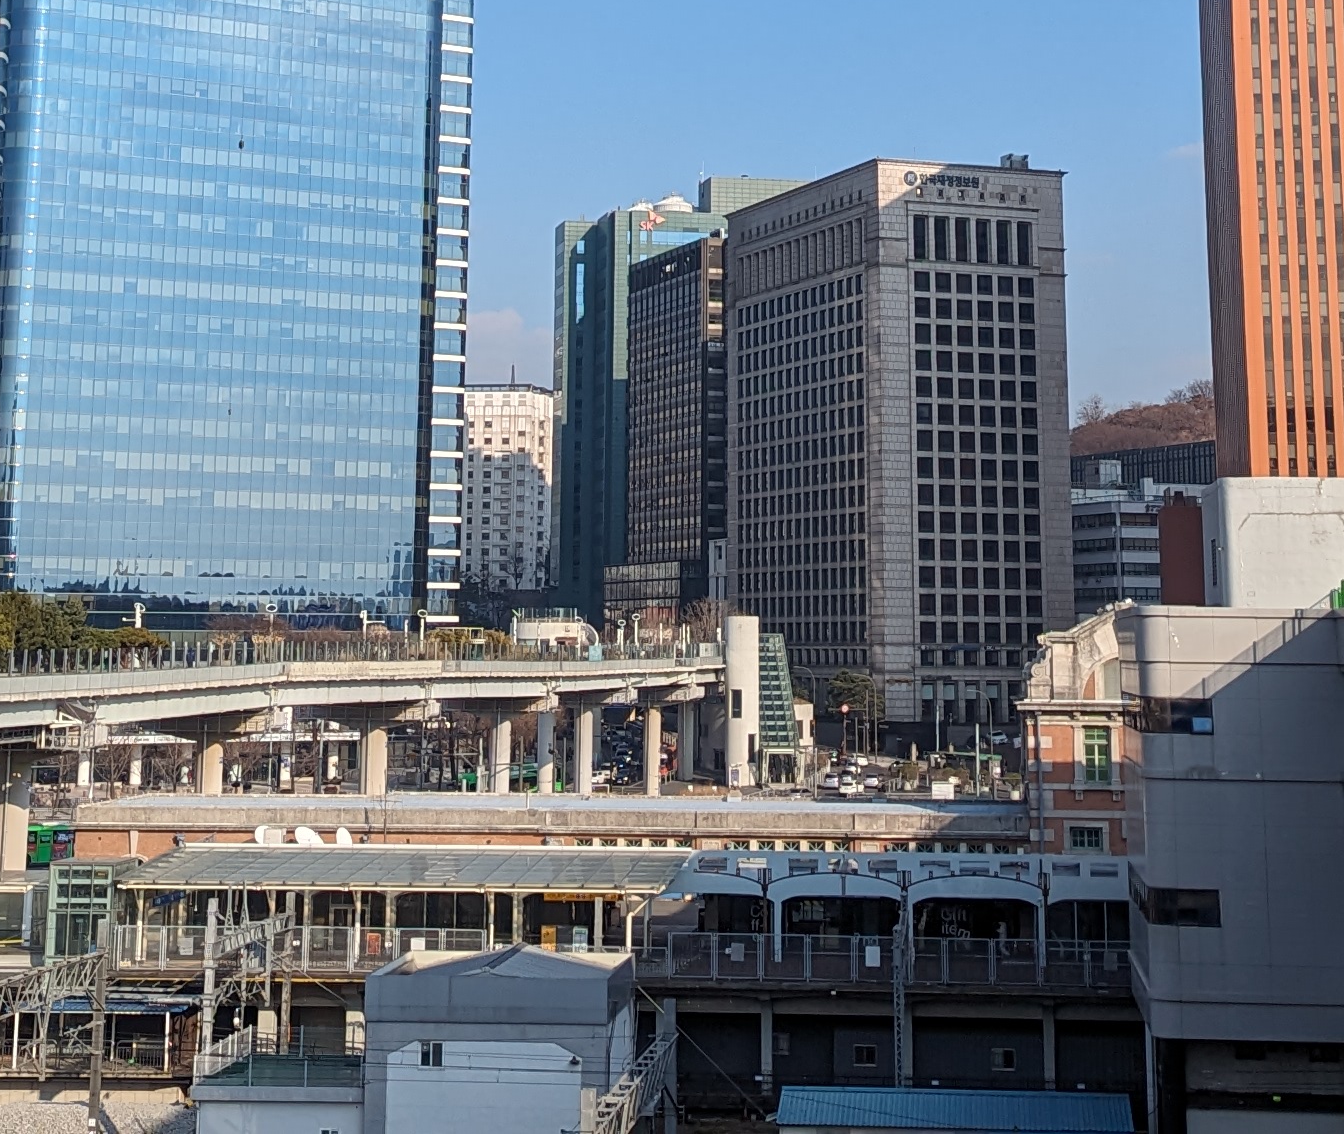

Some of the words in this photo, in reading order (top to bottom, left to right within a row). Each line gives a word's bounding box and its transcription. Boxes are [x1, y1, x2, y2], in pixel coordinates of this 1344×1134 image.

[919, 172, 980, 188] 한국재정정보원
[639, 220, 654, 231] SK
[941, 906, 967, 922] Gift
[941, 922, 971, 939] item
